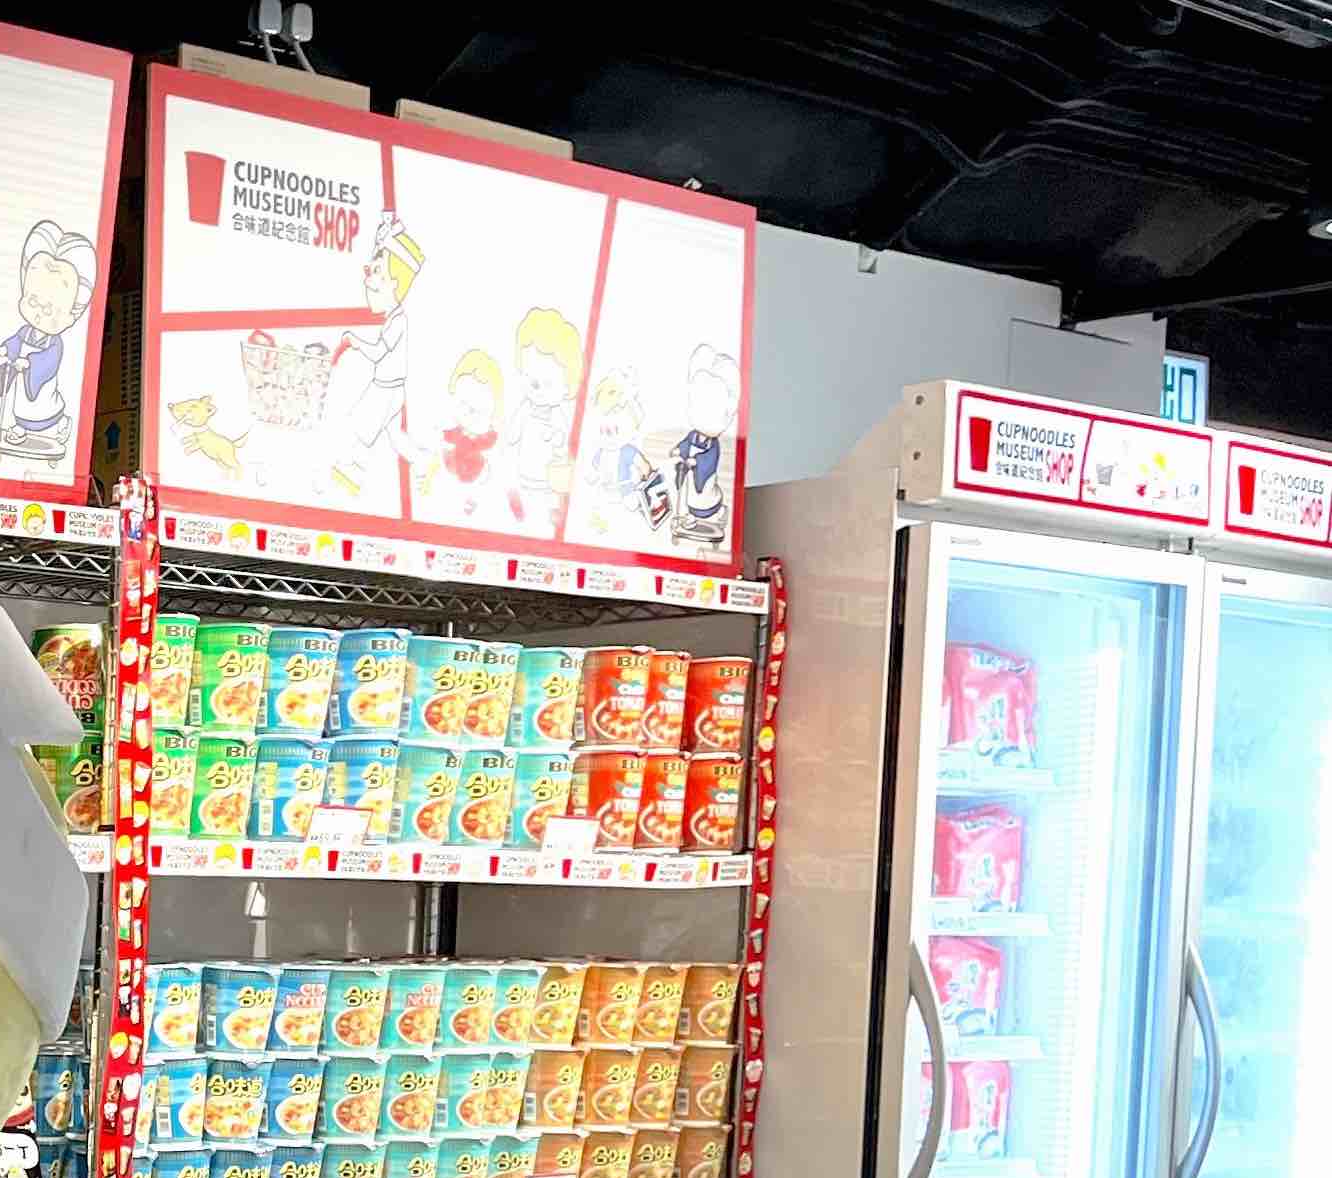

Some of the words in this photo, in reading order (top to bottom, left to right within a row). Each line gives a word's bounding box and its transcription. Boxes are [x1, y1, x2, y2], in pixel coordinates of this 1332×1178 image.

[234, 161, 360, 206] CUPNOODLES
[232, 212, 310, 246] 合味道紀念館
[233, 185, 311, 221] MUSEUM
[313, 202, 359, 252] SHOP
[997, 421, 1076, 450] CUPNOODLES
[996, 441, 1044, 463] MUSEUM
[1046, 448, 1074, 484] SHOP
